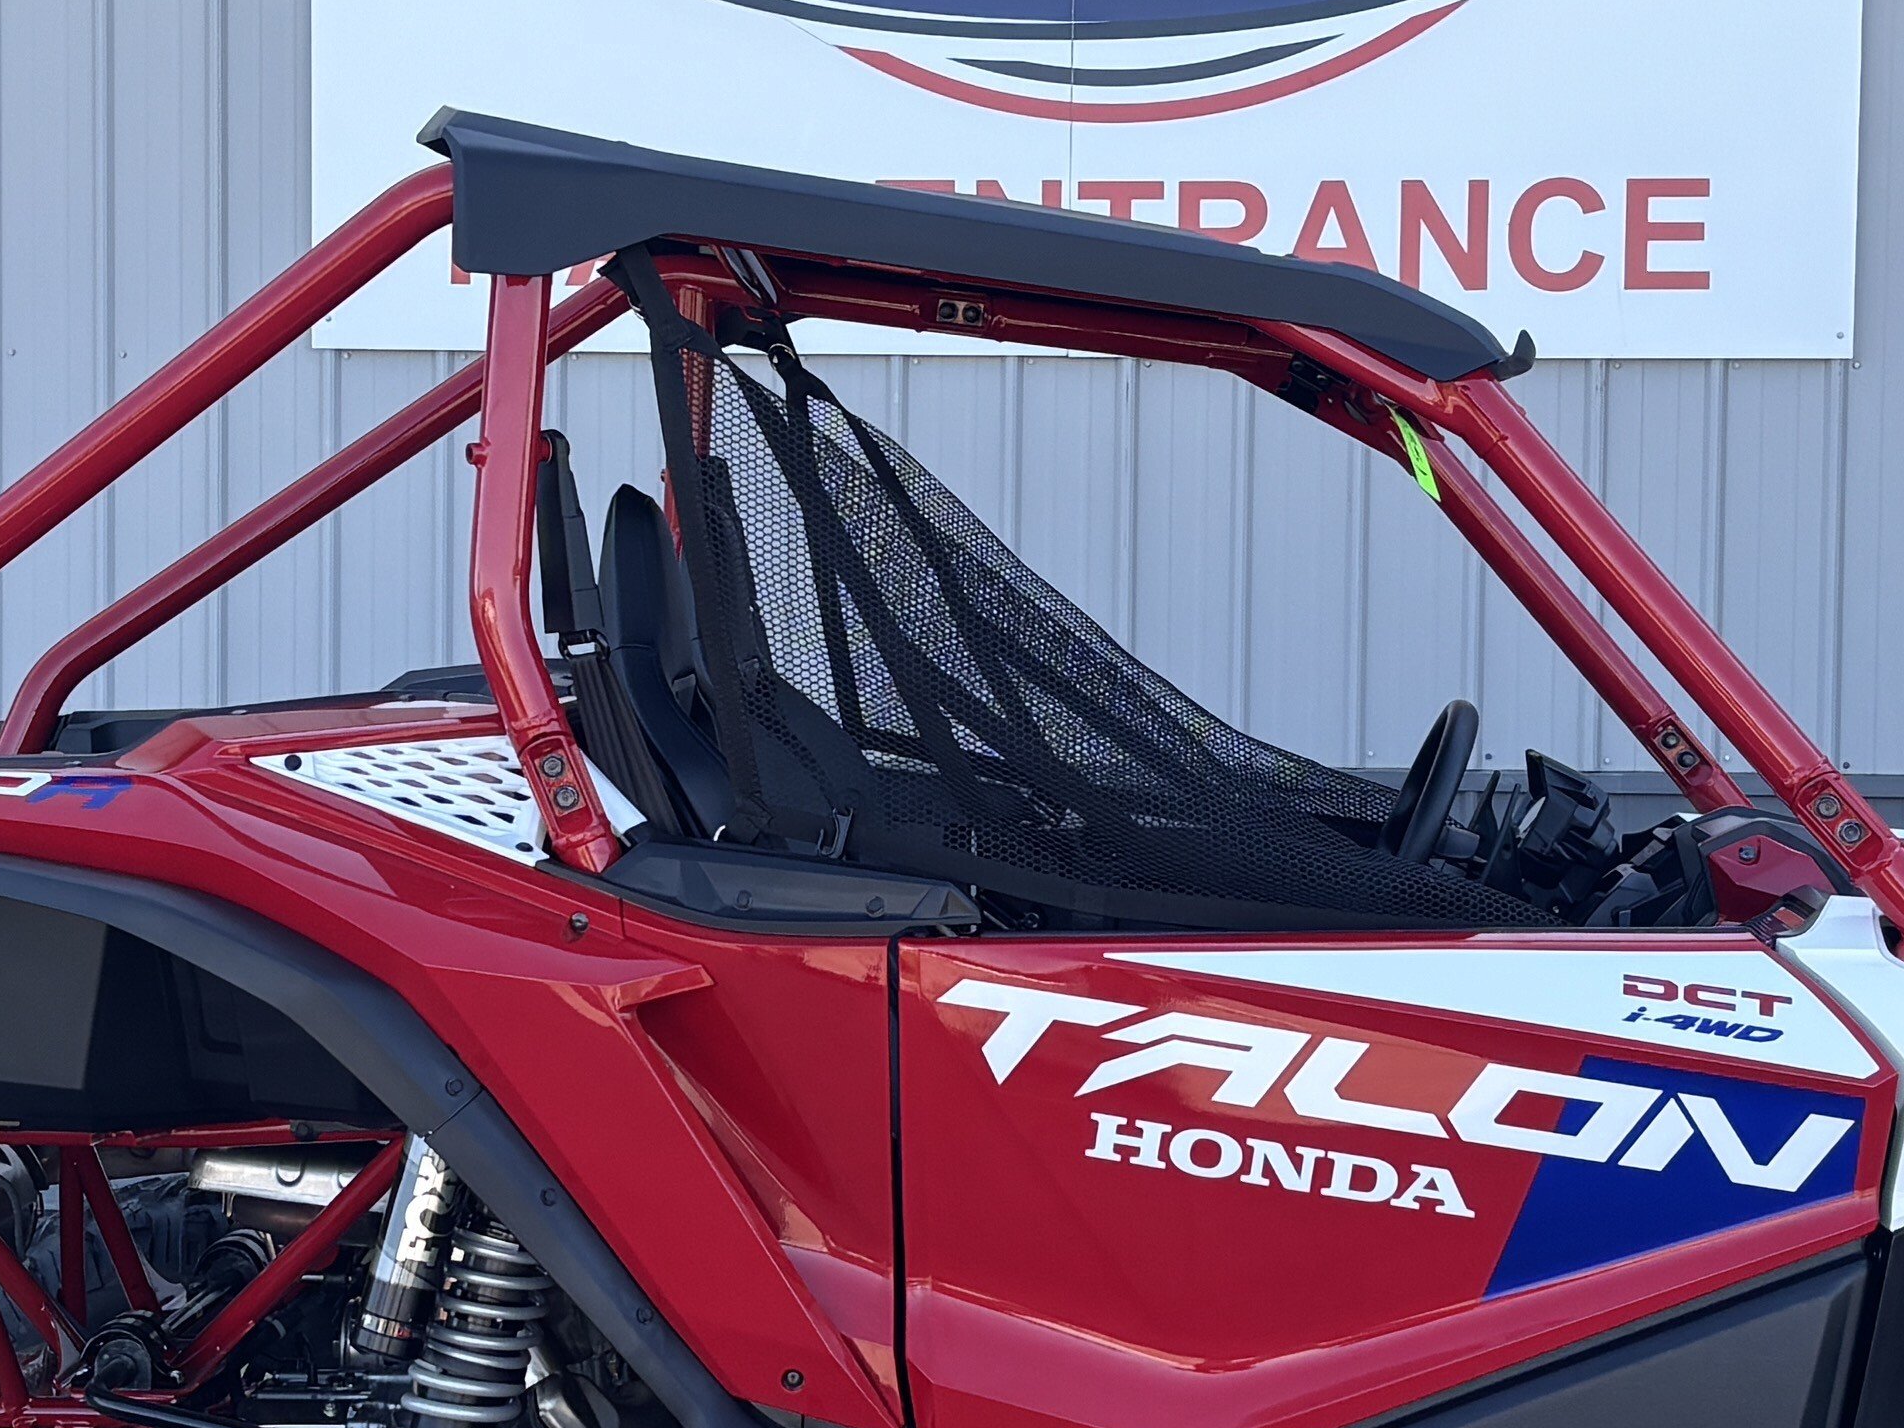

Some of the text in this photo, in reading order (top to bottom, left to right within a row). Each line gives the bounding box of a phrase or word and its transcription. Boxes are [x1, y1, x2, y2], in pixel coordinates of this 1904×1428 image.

[1621, 1006, 1784, 1043] i-4WD
[1622, 974, 1793, 1018] DCT
[940, 980, 1856, 1192] TALON
[396, 1154, 457, 1266] FOX
[1084, 1112, 1475, 1219] HONDA
